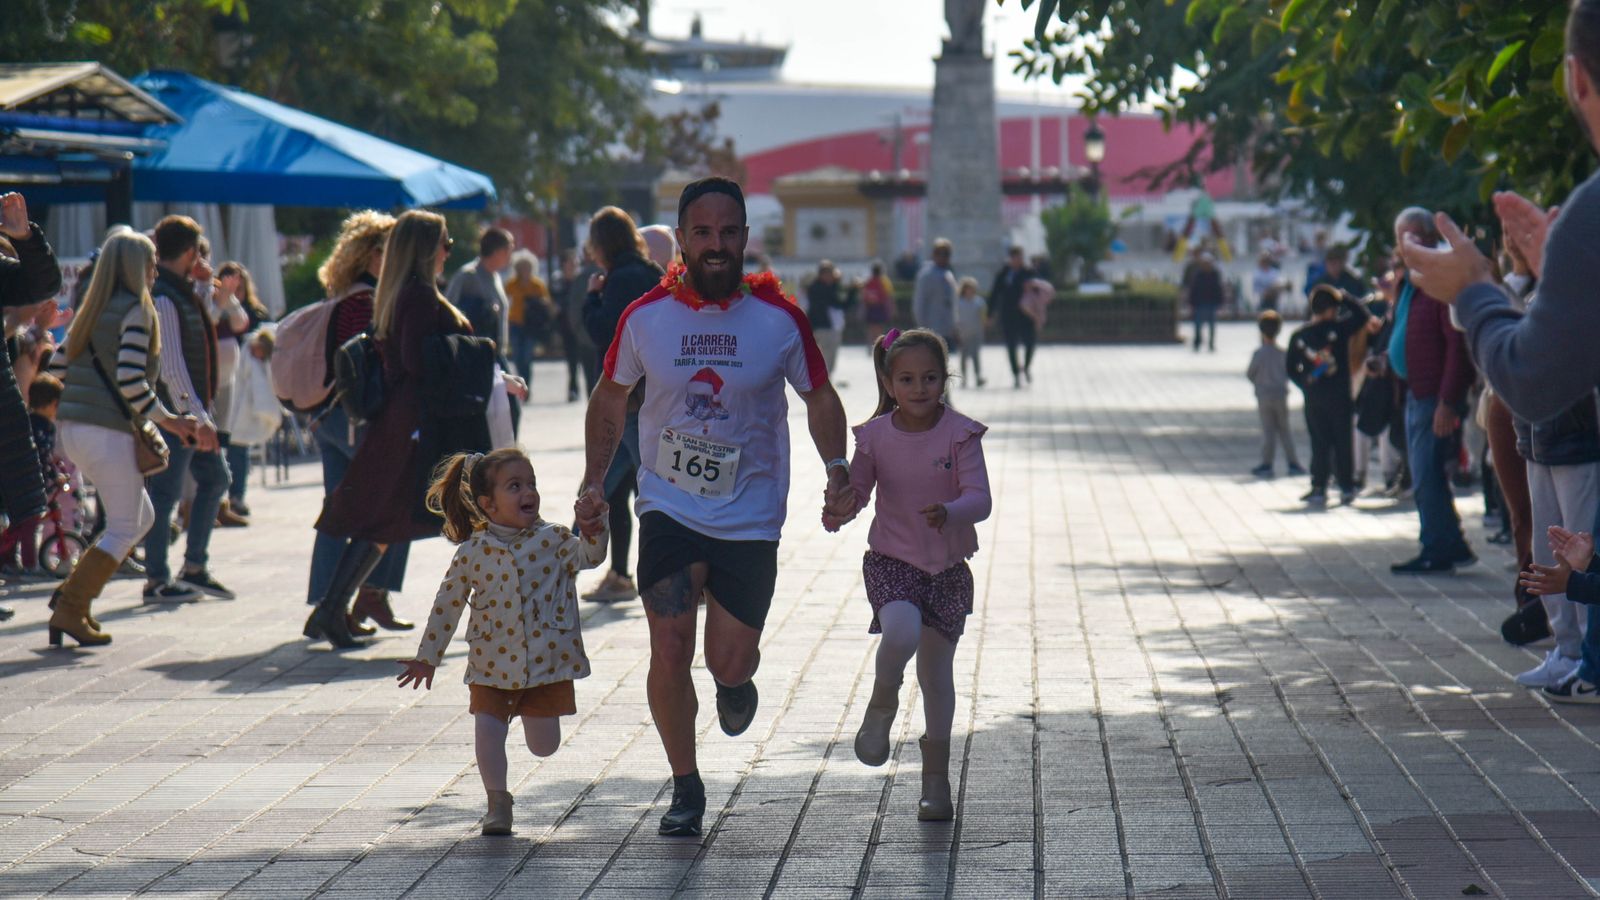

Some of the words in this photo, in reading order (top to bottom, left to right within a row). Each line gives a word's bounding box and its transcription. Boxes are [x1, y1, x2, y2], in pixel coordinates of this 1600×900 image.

[682, 335, 688, 346] II
[690, 334, 737, 346] CARRERA
[681, 346, 696, 356] SAN
[698, 346, 736, 356] SILVESTRE
[699, 440, 736, 454] SILVESTRE
[672, 450, 720, 482] 165
